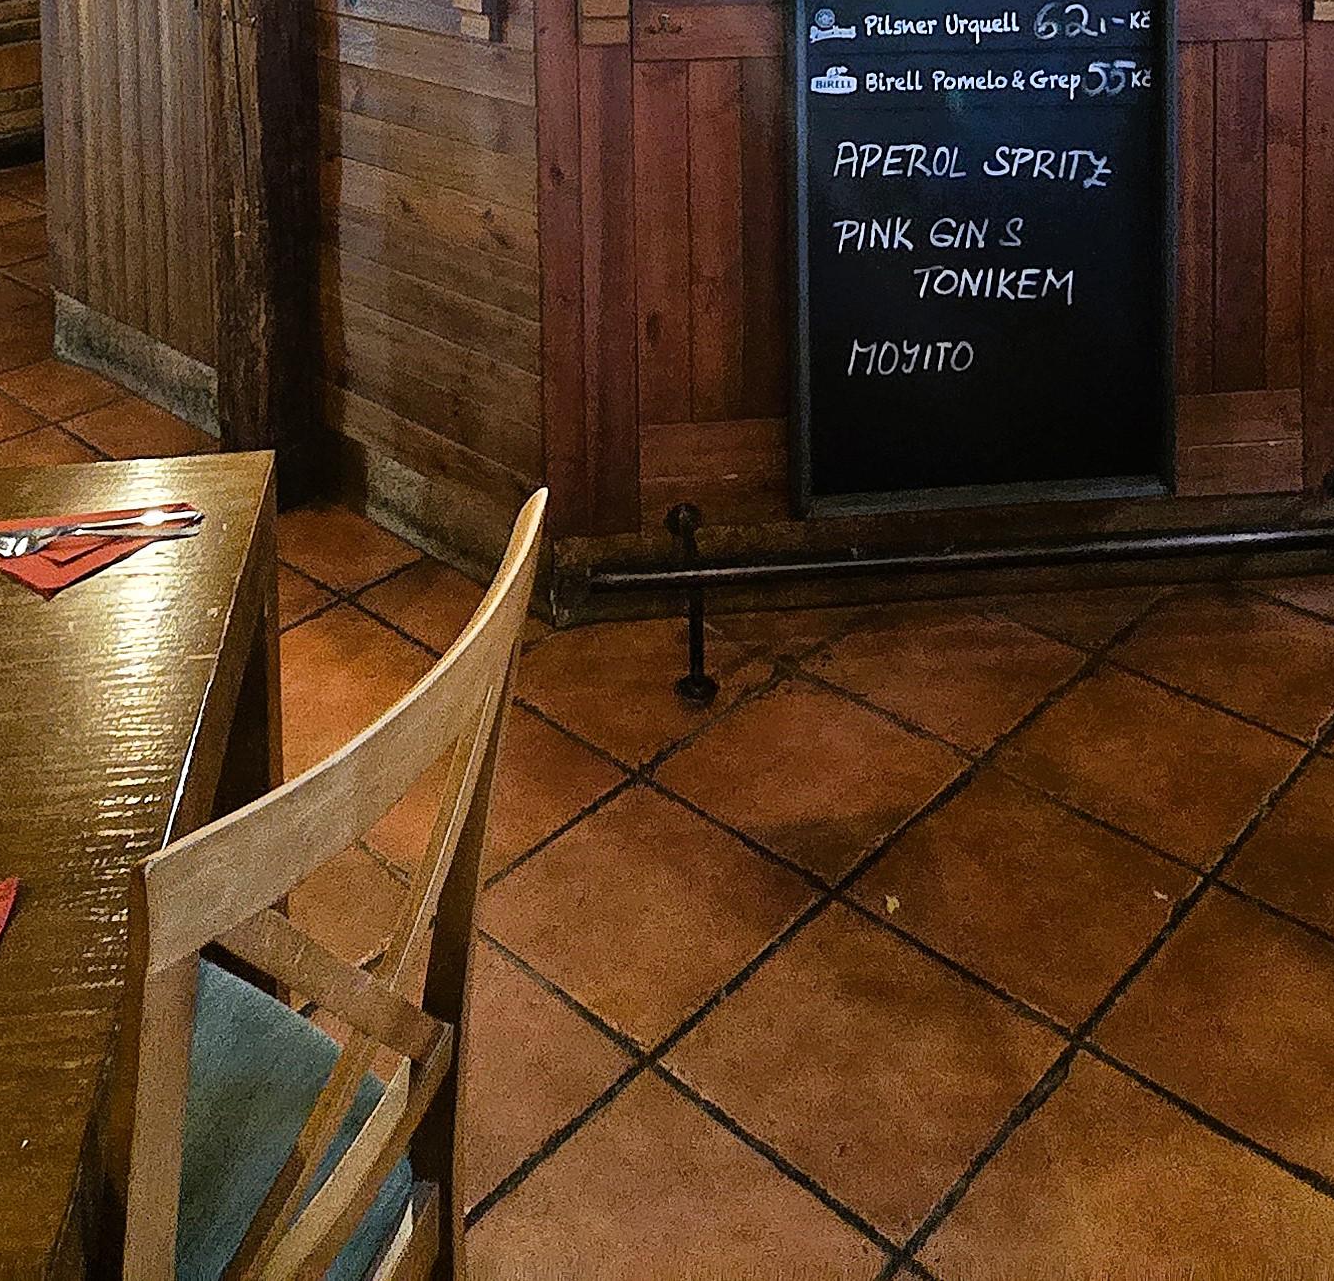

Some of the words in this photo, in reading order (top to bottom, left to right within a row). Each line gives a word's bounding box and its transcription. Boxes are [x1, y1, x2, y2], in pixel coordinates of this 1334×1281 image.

[864, 13, 938, 36] Pilsner
[945, 11, 1020, 44] Urquell
[1129, 10, 1152, 30] Kč
[865, 71, 924, 92] Birell
[932, 70, 1009, 92] Pomelo
[1011, 72, 1027, 91] &
[1029, 70, 1082, 100] Grep
[1083, 59, 1137, 96] 55
[1130, 68, 1152, 89] Kč
[833, 141, 967, 178] APEROL
[983, 145, 1113, 189] SPRITZ
[832, 217, 914, 254] PINK
[929, 217, 990, 249] GIN
[998, 217, 1024, 247] S
[913, 264, 1075, 306] TONIKEM
